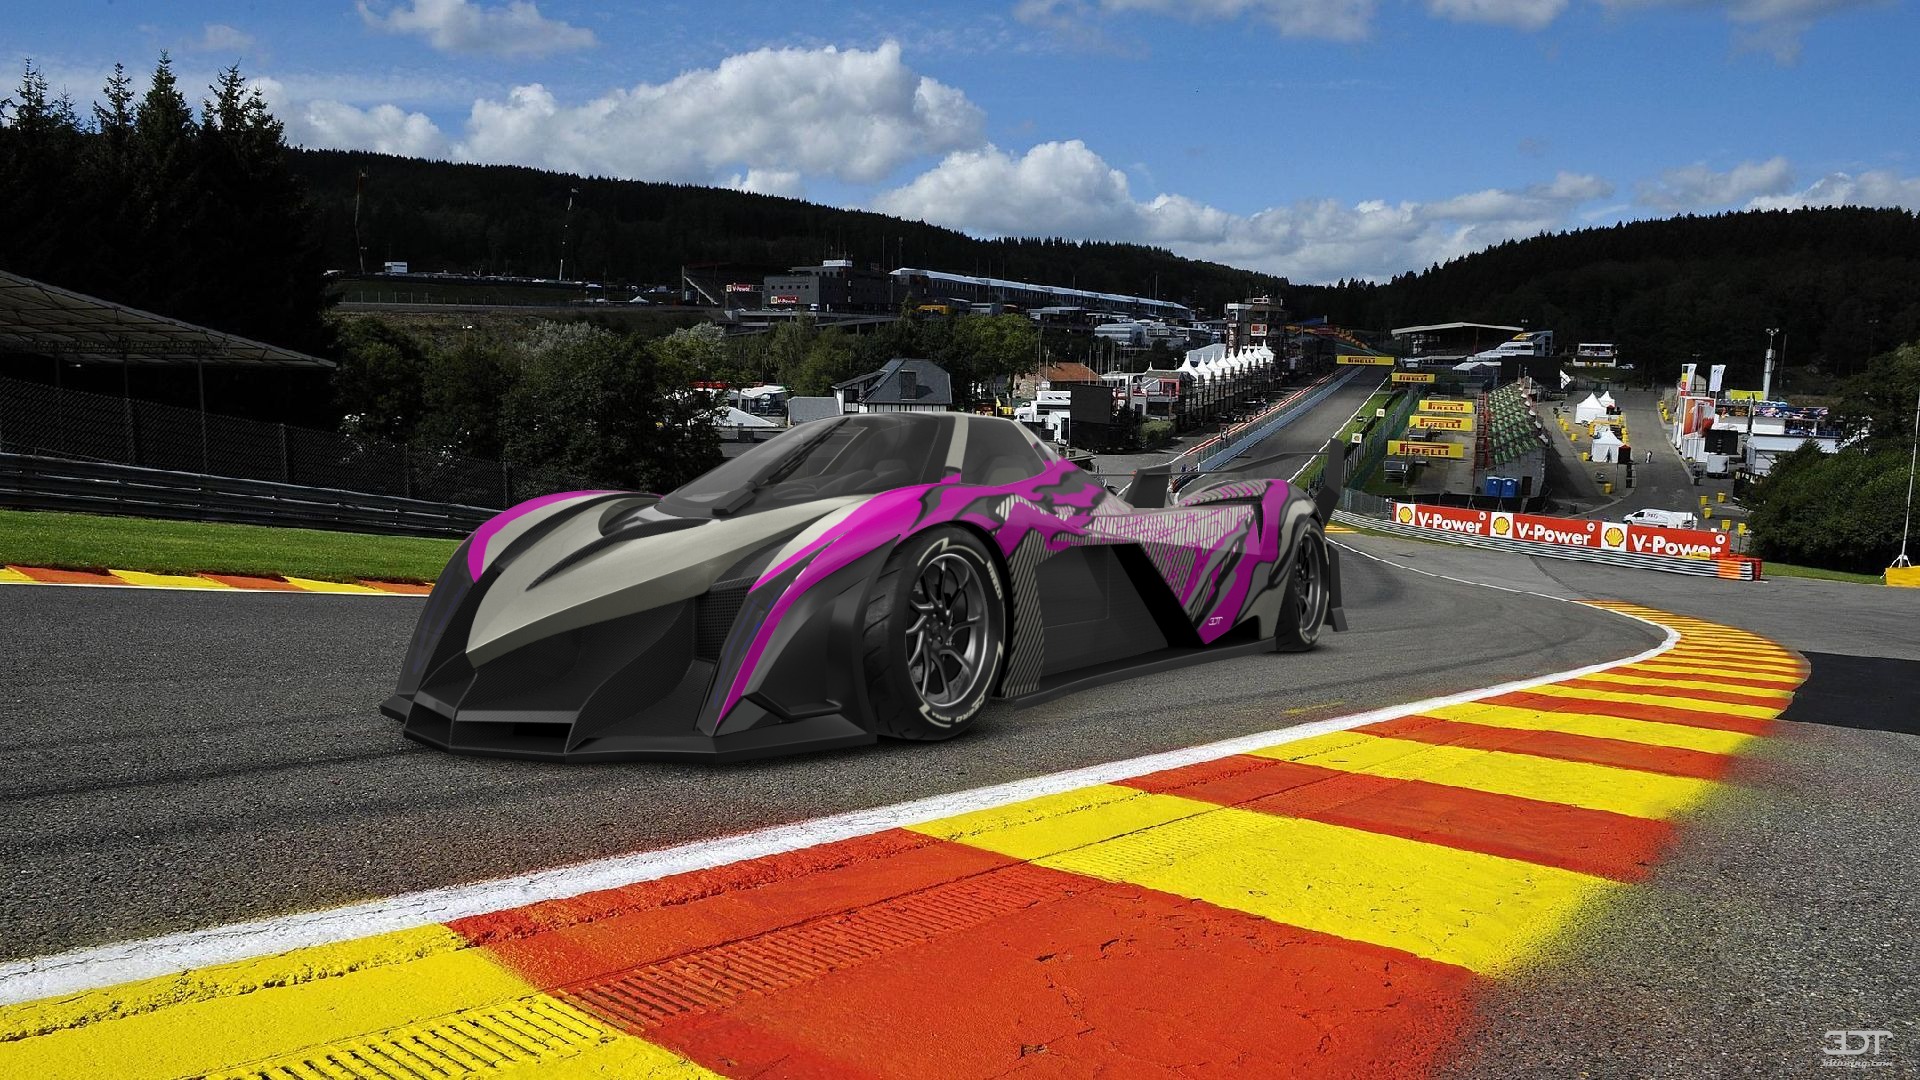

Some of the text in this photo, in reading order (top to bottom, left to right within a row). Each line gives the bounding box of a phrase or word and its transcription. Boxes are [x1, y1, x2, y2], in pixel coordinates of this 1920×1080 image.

[1399, 374, 1428, 382] PIRELLI
[1427, 402, 1465, 411] PIRELLI
[1420, 418, 1462, 429] PIRELLI
[1400, 443, 1450, 456] PIRELLI
[1417, 511, 1482, 534] V-Power
[1516, 521, 1592, 546] V-Power
[1631, 533, 1722, 556] V-Power
